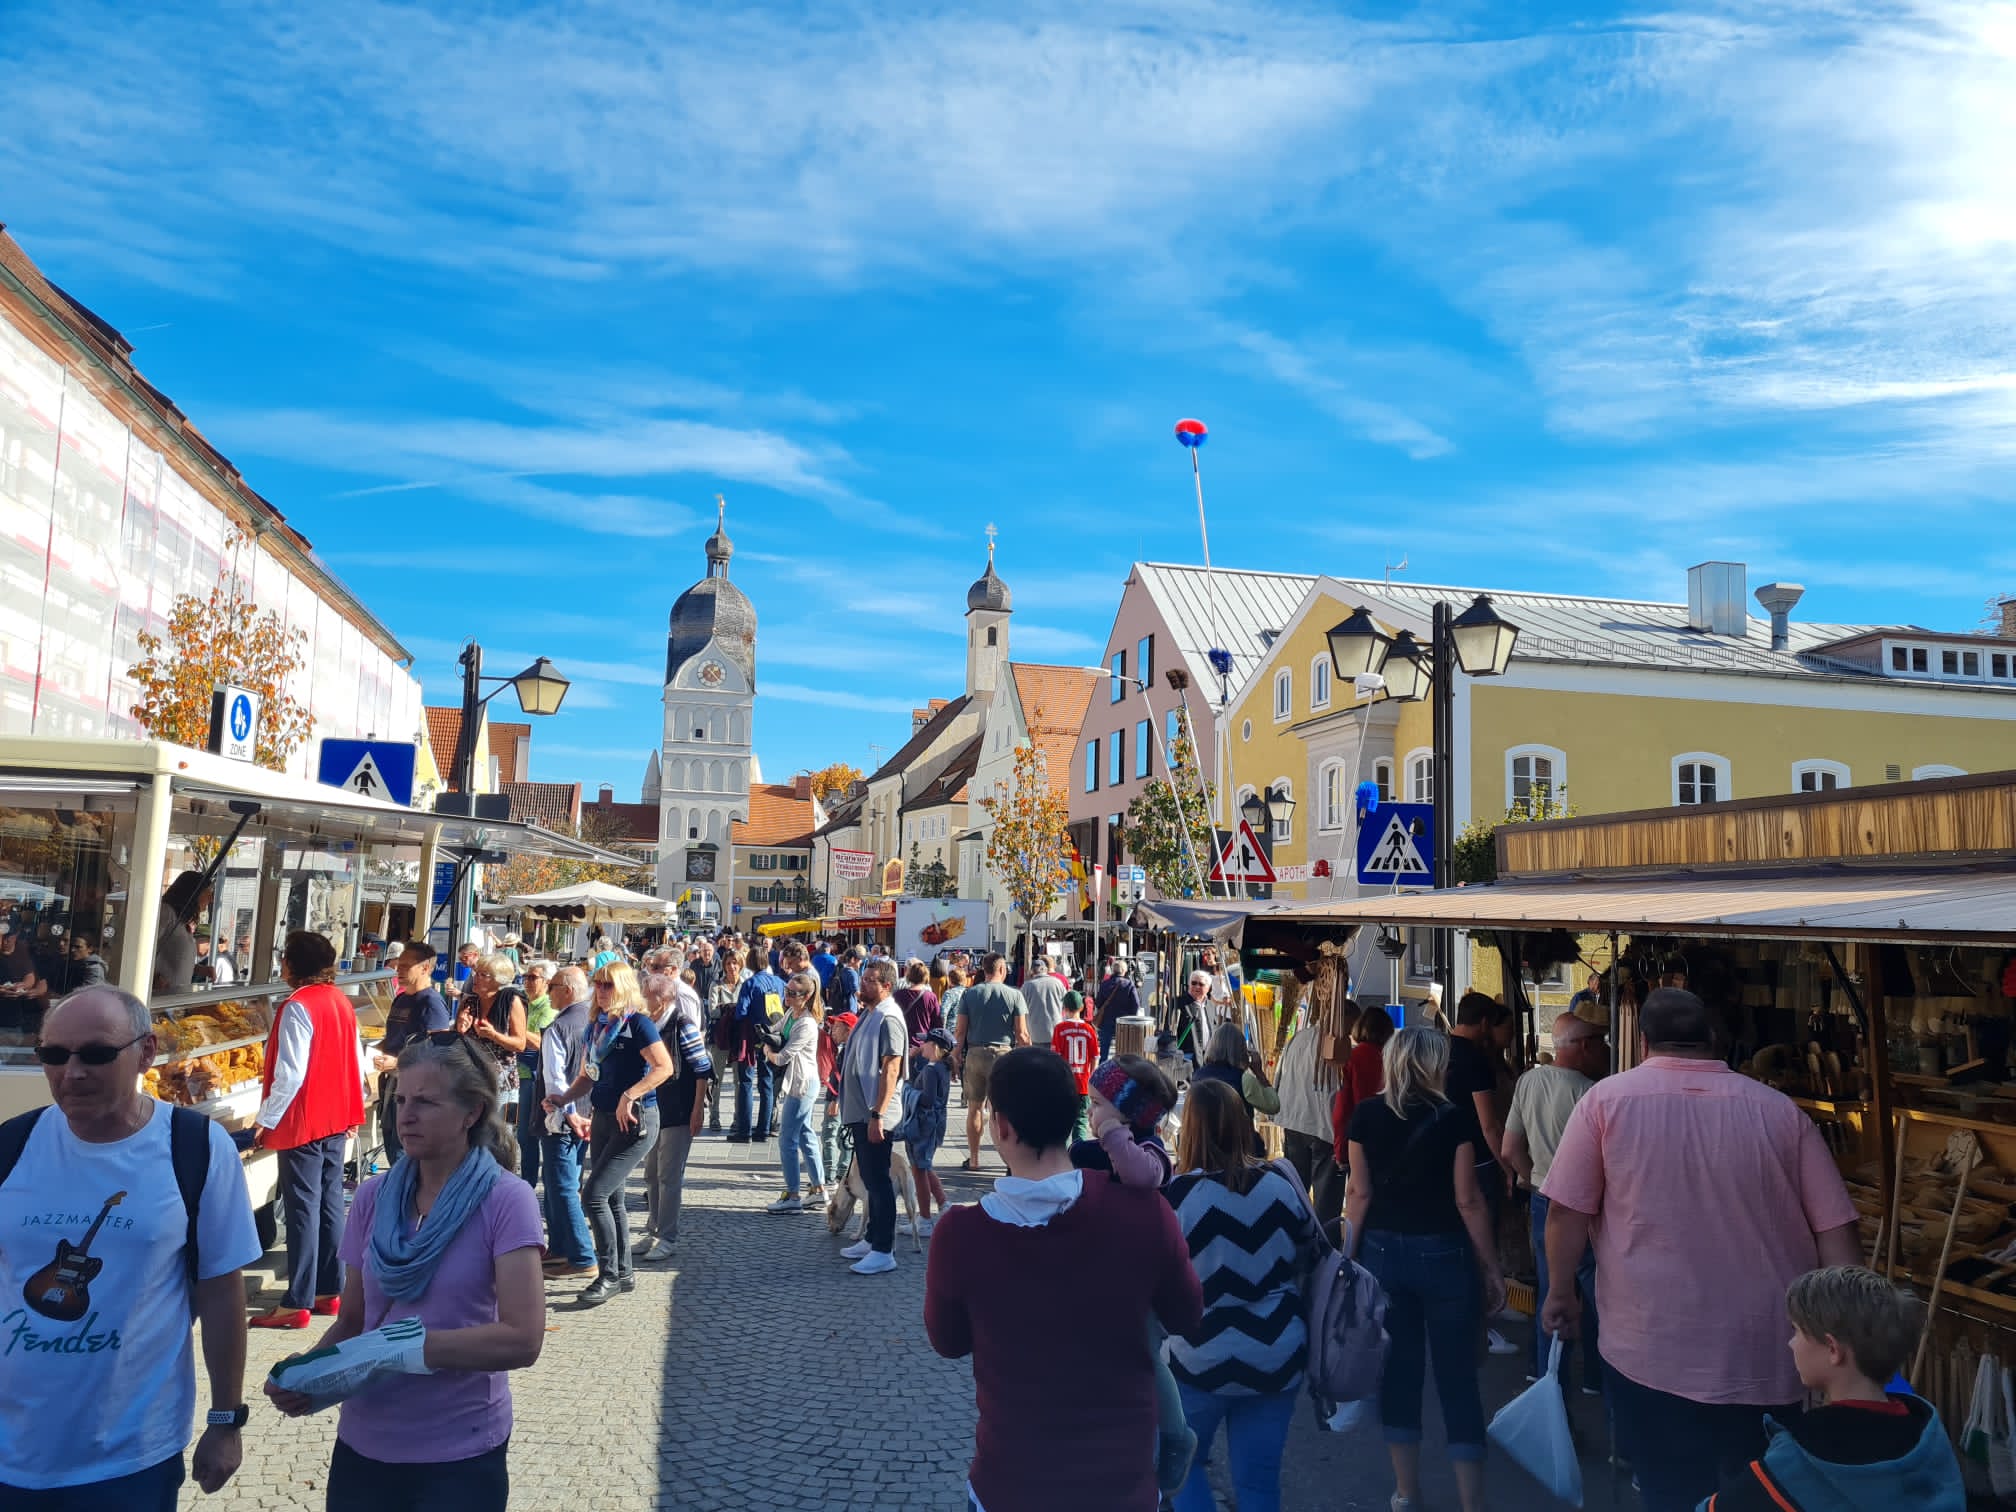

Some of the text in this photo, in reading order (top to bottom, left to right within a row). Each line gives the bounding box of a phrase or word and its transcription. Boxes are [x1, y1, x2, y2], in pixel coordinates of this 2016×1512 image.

[229, 743, 247, 757] ZONE
[1066, 1035, 1087, 1065] 10
[21, 1213, 135, 1230] JAZZMATER
[2, 1309, 121, 1357] Fender
